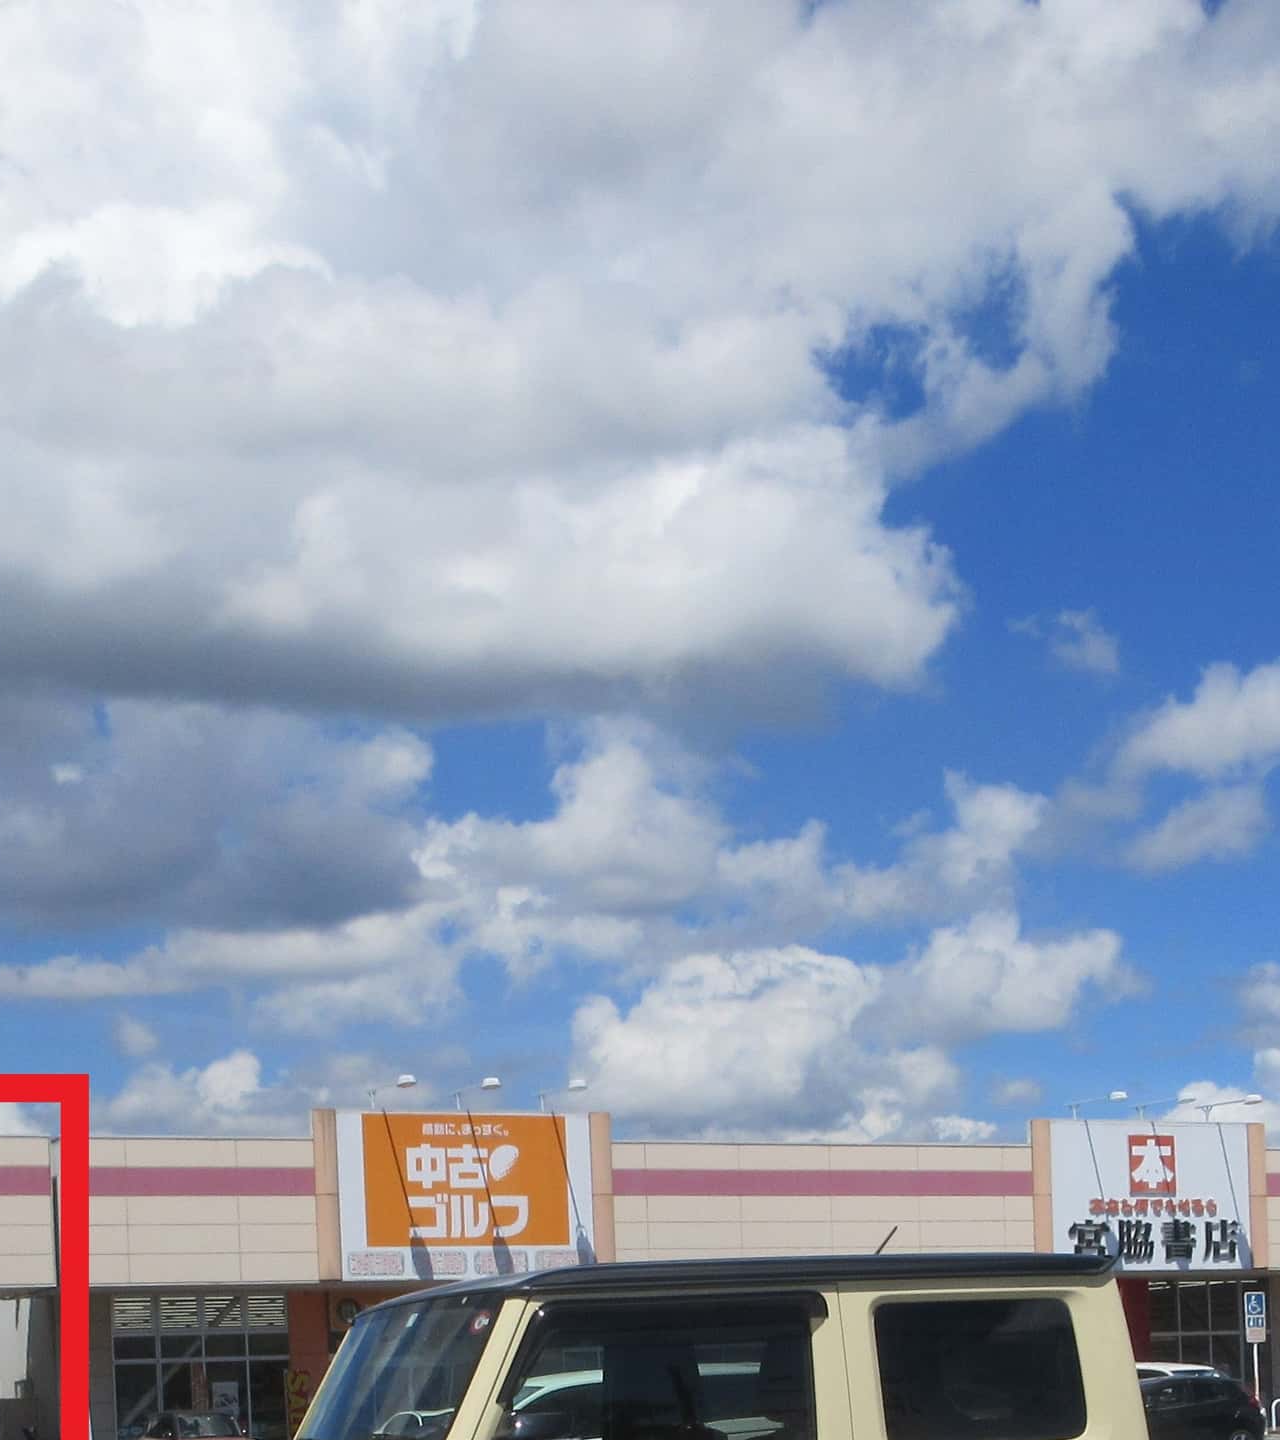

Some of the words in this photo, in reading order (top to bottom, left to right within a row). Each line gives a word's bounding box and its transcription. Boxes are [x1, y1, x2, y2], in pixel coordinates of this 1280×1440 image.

[406, 1143, 489, 1189] 中古
[407, 1192, 529, 1239] ゴルフ
[1067, 1218, 1242, 1265] 宮脇書店
